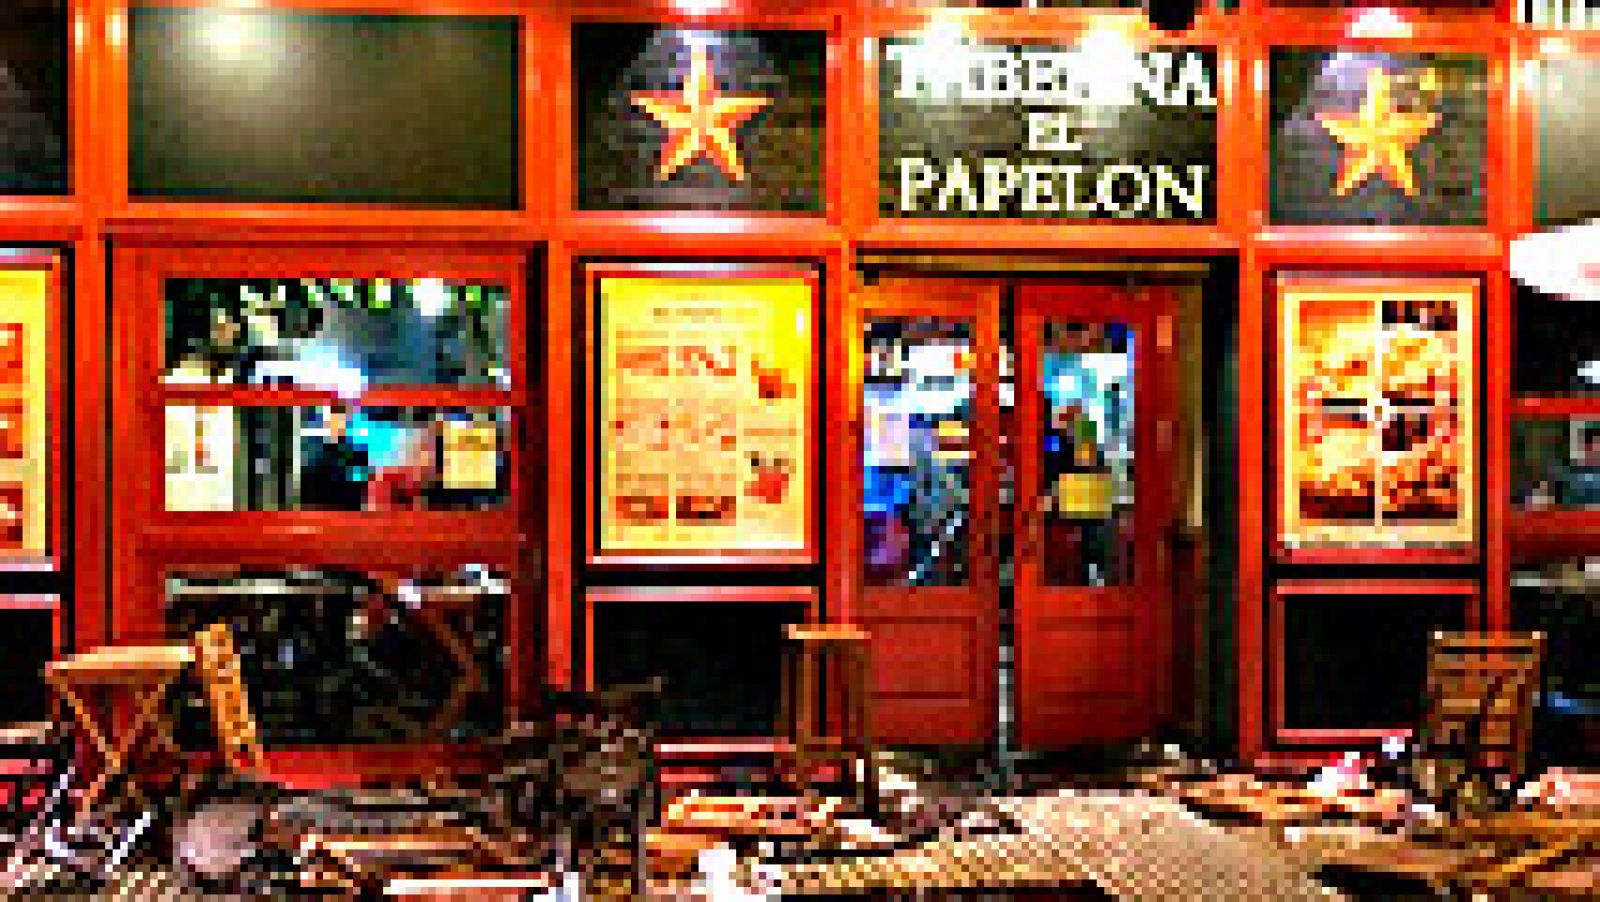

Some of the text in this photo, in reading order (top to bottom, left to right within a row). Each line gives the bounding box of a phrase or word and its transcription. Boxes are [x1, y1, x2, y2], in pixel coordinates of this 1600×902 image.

[887, 44, 1216, 105] TBENA
[1028, 112, 1082, 151] EL
[895, 157, 1209, 218] PAPELON
